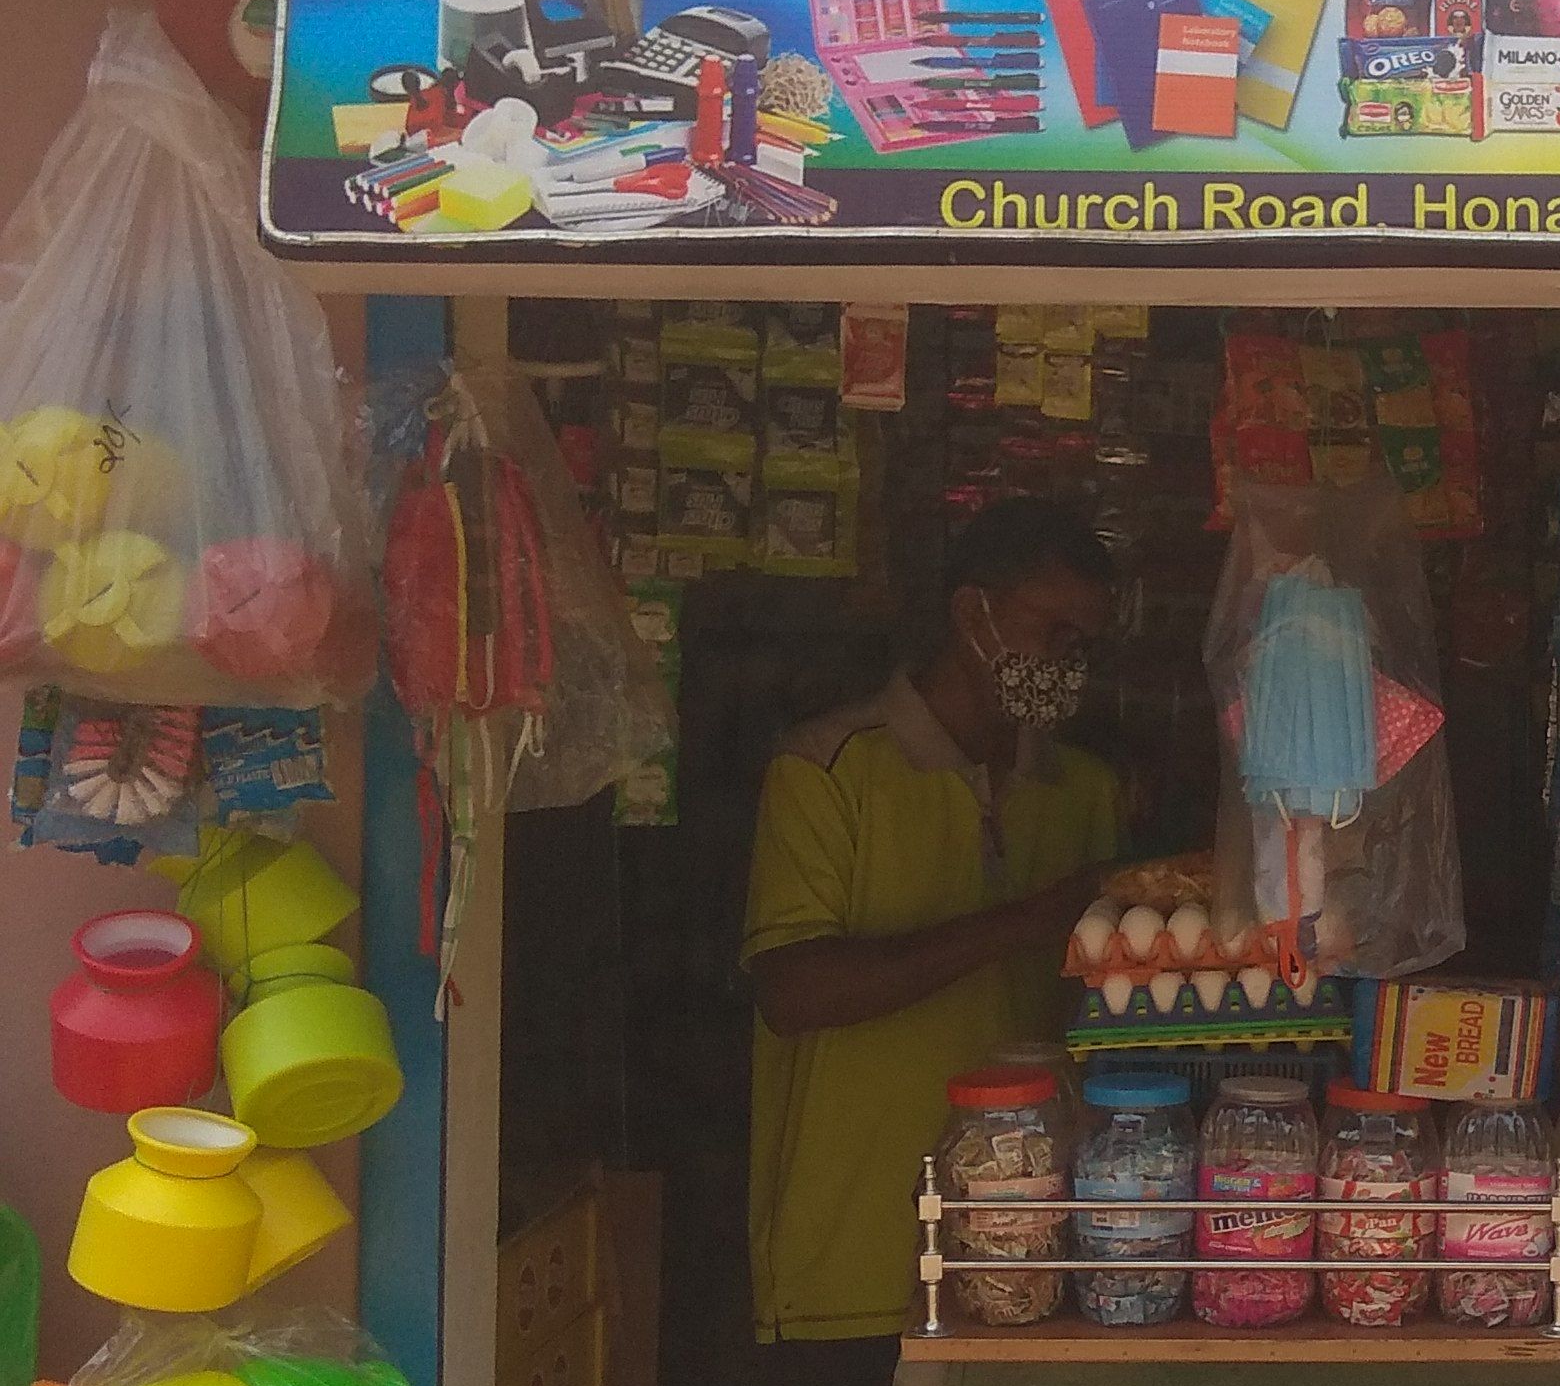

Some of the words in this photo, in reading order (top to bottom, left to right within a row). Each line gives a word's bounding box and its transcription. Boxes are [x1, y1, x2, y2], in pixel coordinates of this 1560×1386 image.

[1368, 49, 1436, 77] OREO
[1497, 50, 1557, 65] MILANO
[1499, 91, 1551, 107] GOLDEN
[940, 180, 1179, 232] Church
[1455, 1000, 1486, 1064] BREAD
[1412, 1031, 1451, 1087] New
[1466, 1215, 1529, 1243] Wave
